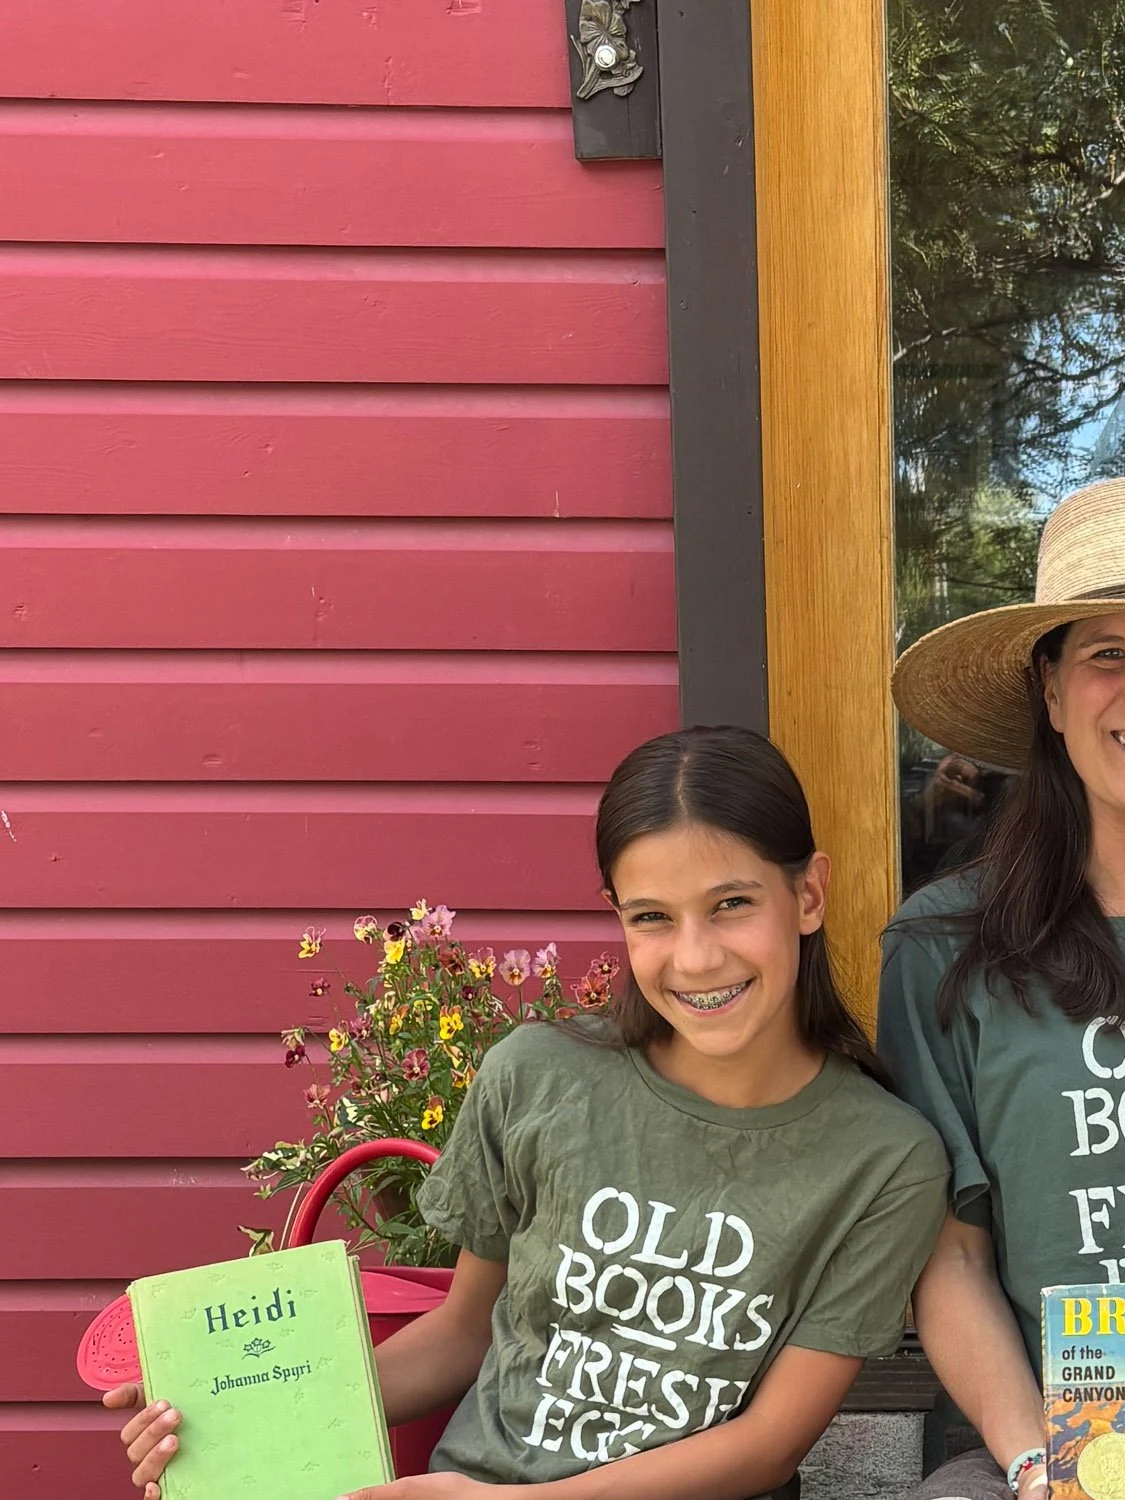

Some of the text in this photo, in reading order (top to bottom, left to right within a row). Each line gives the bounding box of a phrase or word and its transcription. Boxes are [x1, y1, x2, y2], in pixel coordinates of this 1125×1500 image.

[582, 1187, 754, 1277] OLD
[204, 1287, 297, 1335] Heidi
[552, 1244, 774, 1351] BOOKS
[1061, 1345, 1102, 1360] of the
[210, 1359, 312, 1396] Johanna Spyri
[1062, 1366, 1115, 1381] GRAND
[1062, 1387, 1125, 1402] CANYON
